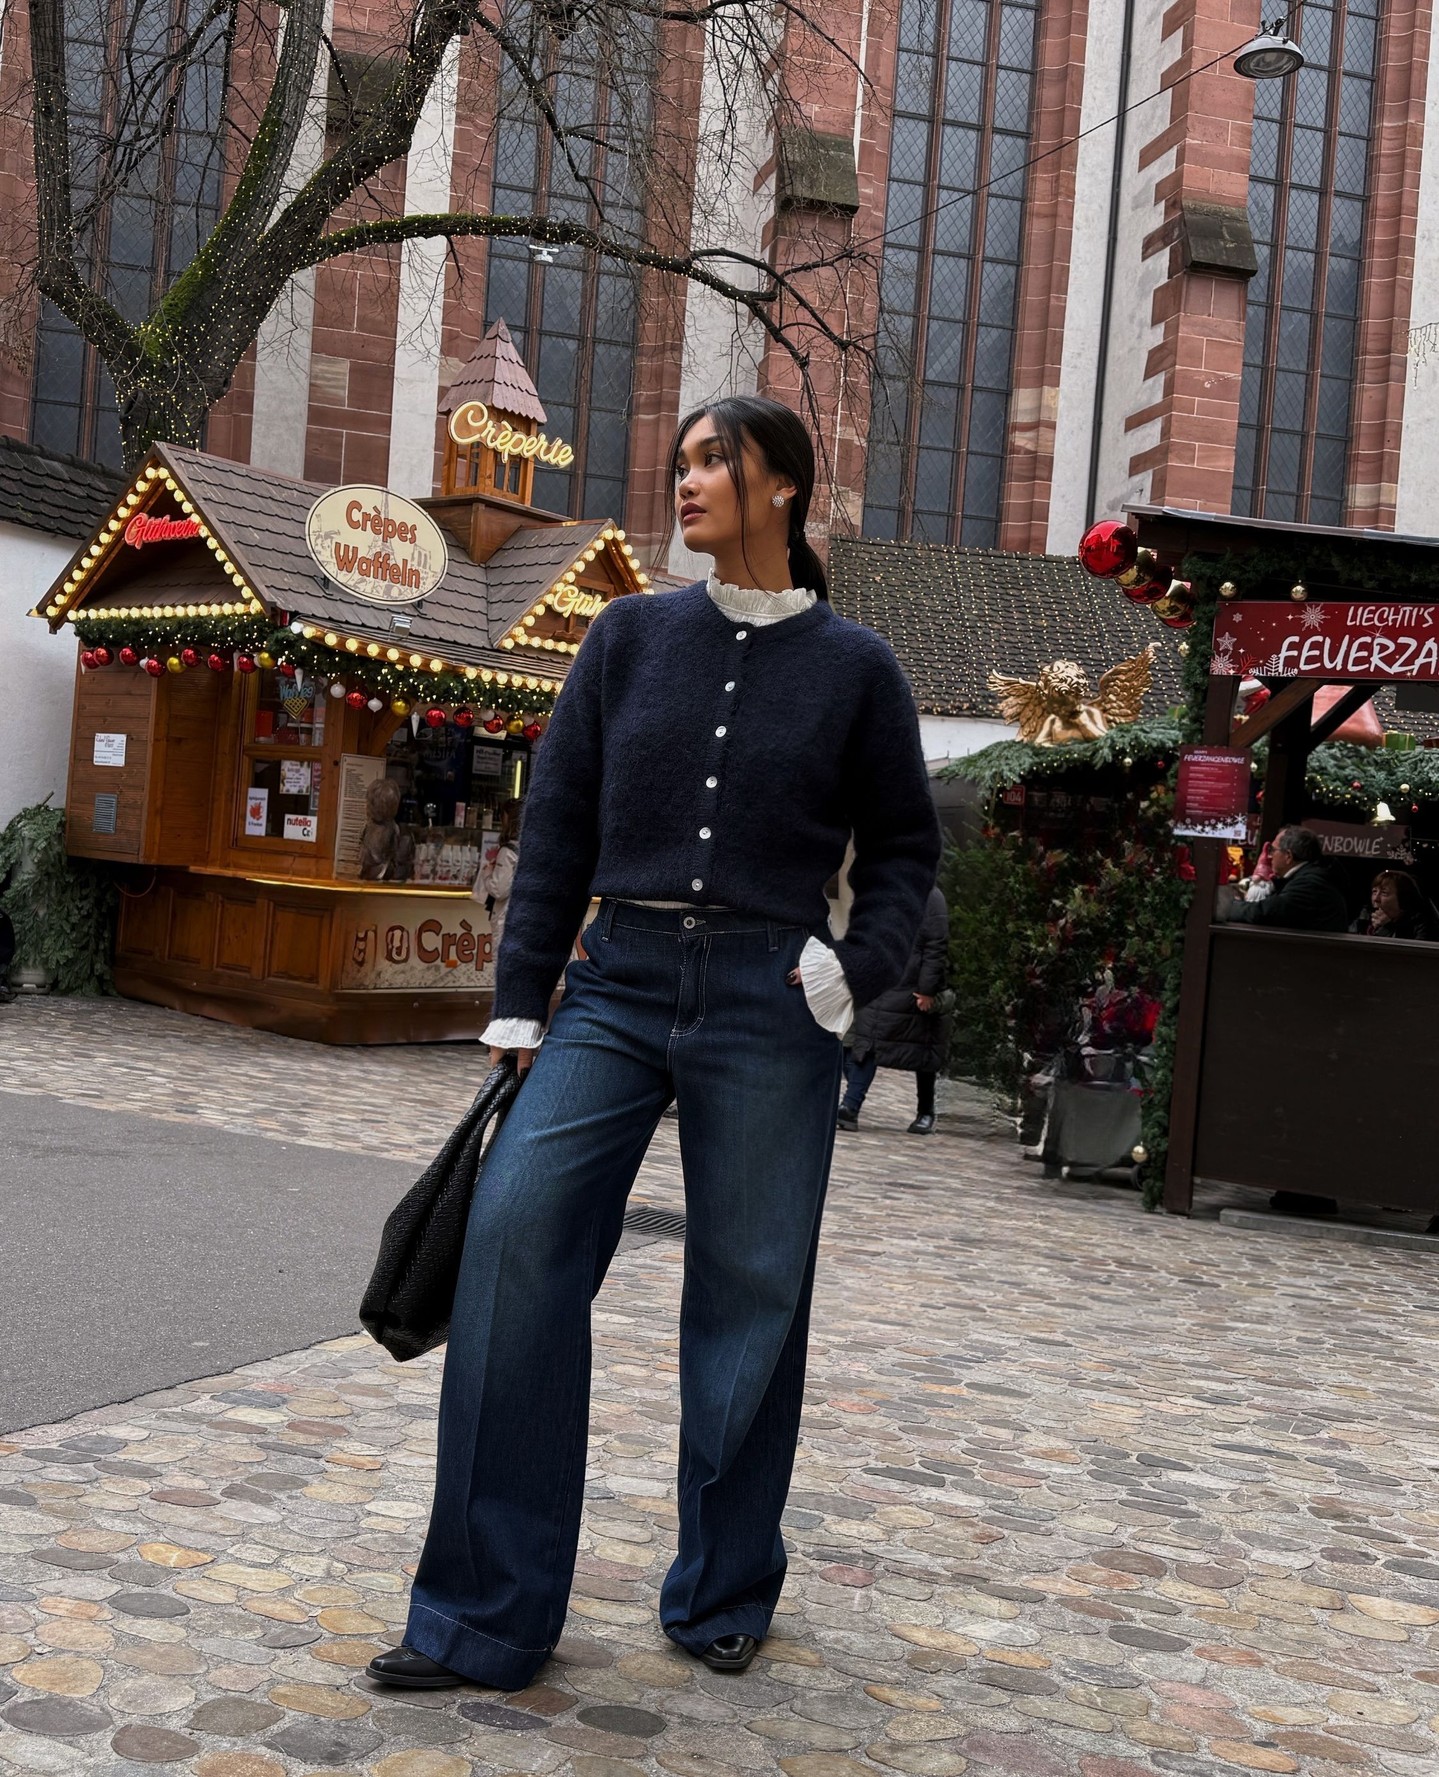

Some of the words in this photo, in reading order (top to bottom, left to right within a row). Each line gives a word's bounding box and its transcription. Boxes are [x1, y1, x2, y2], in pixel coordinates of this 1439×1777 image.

[449, 399, 575, 468] Crèperie
[345, 500, 418, 544] Crèpes
[334, 542, 421, 589] Waffeln
[1346, 605, 1435, 628] LIECHTI'S
[1318, 834, 1381, 855] NBOWLE
